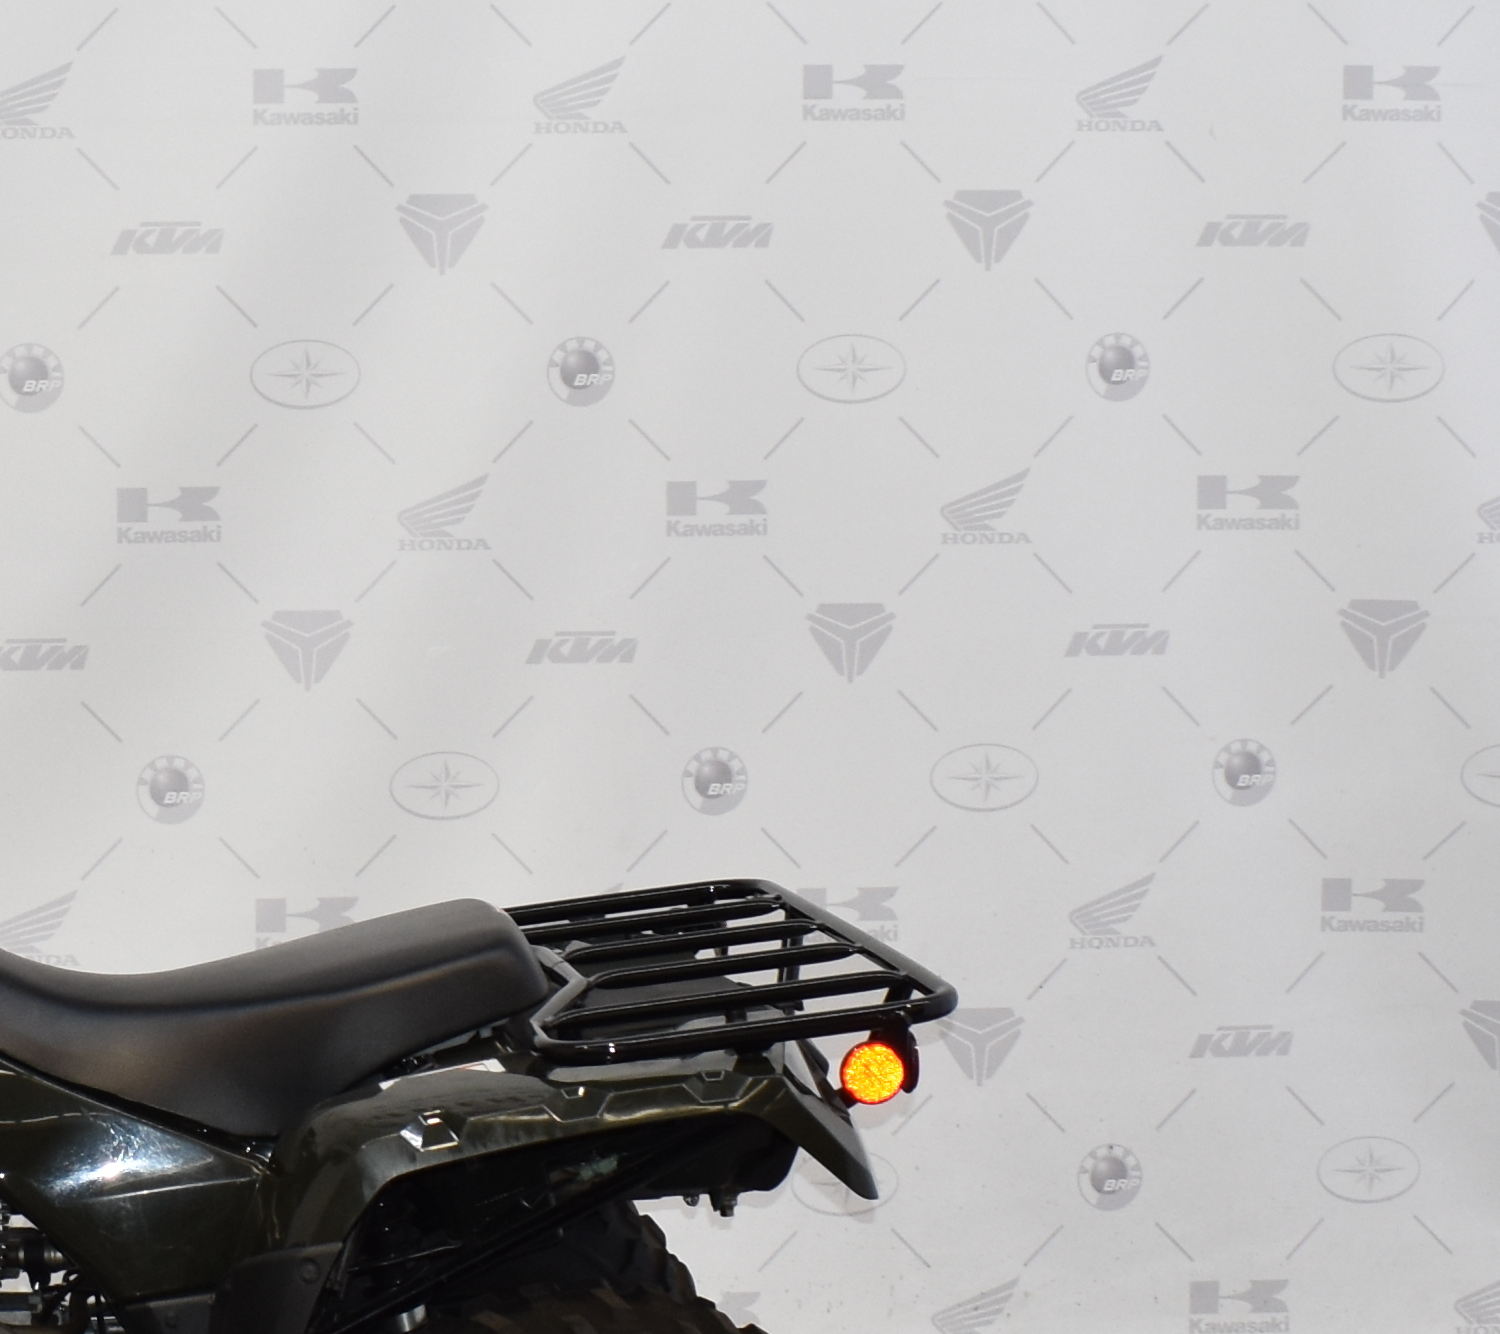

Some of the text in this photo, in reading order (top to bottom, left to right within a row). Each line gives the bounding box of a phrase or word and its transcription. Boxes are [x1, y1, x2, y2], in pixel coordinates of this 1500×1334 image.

[250, 105, 360, 128] Kawasaki
[800, 101, 906, 124] Kawasaki
[1340, 102, 1443, 124] Kawasaki
[534, 119, 628, 135] HONDA
[1076, 117, 1164, 133] HONDA
[109, 221, 226, 255] KTM
[661, 215, 775, 249] KTM
[1194, 212, 1311, 250] KTM
[22, 378, 63, 394] BRP
[573, 372, 614, 388] BRP
[1110, 368, 1148, 383] BRP
[665, 517, 768, 539] Kawasaki
[1194, 511, 1300, 533] Kawasaki
[116, 524, 222, 545] Kawasaki
[398, 536, 492, 552] HONDA
[940, 531, 1034, 545] HONDA
[525, 629, 639, 665] KTM
[1064, 623, 1171, 657] KTM
[707, 781, 746, 797] BRP
[1319, 912, 1425, 936] Kawasaki
[1069, 934, 1157, 950] HONDA
[1188, 1023, 1295, 1059] KTM
[1187, 1316, 1290, 1334] Kawasaki
